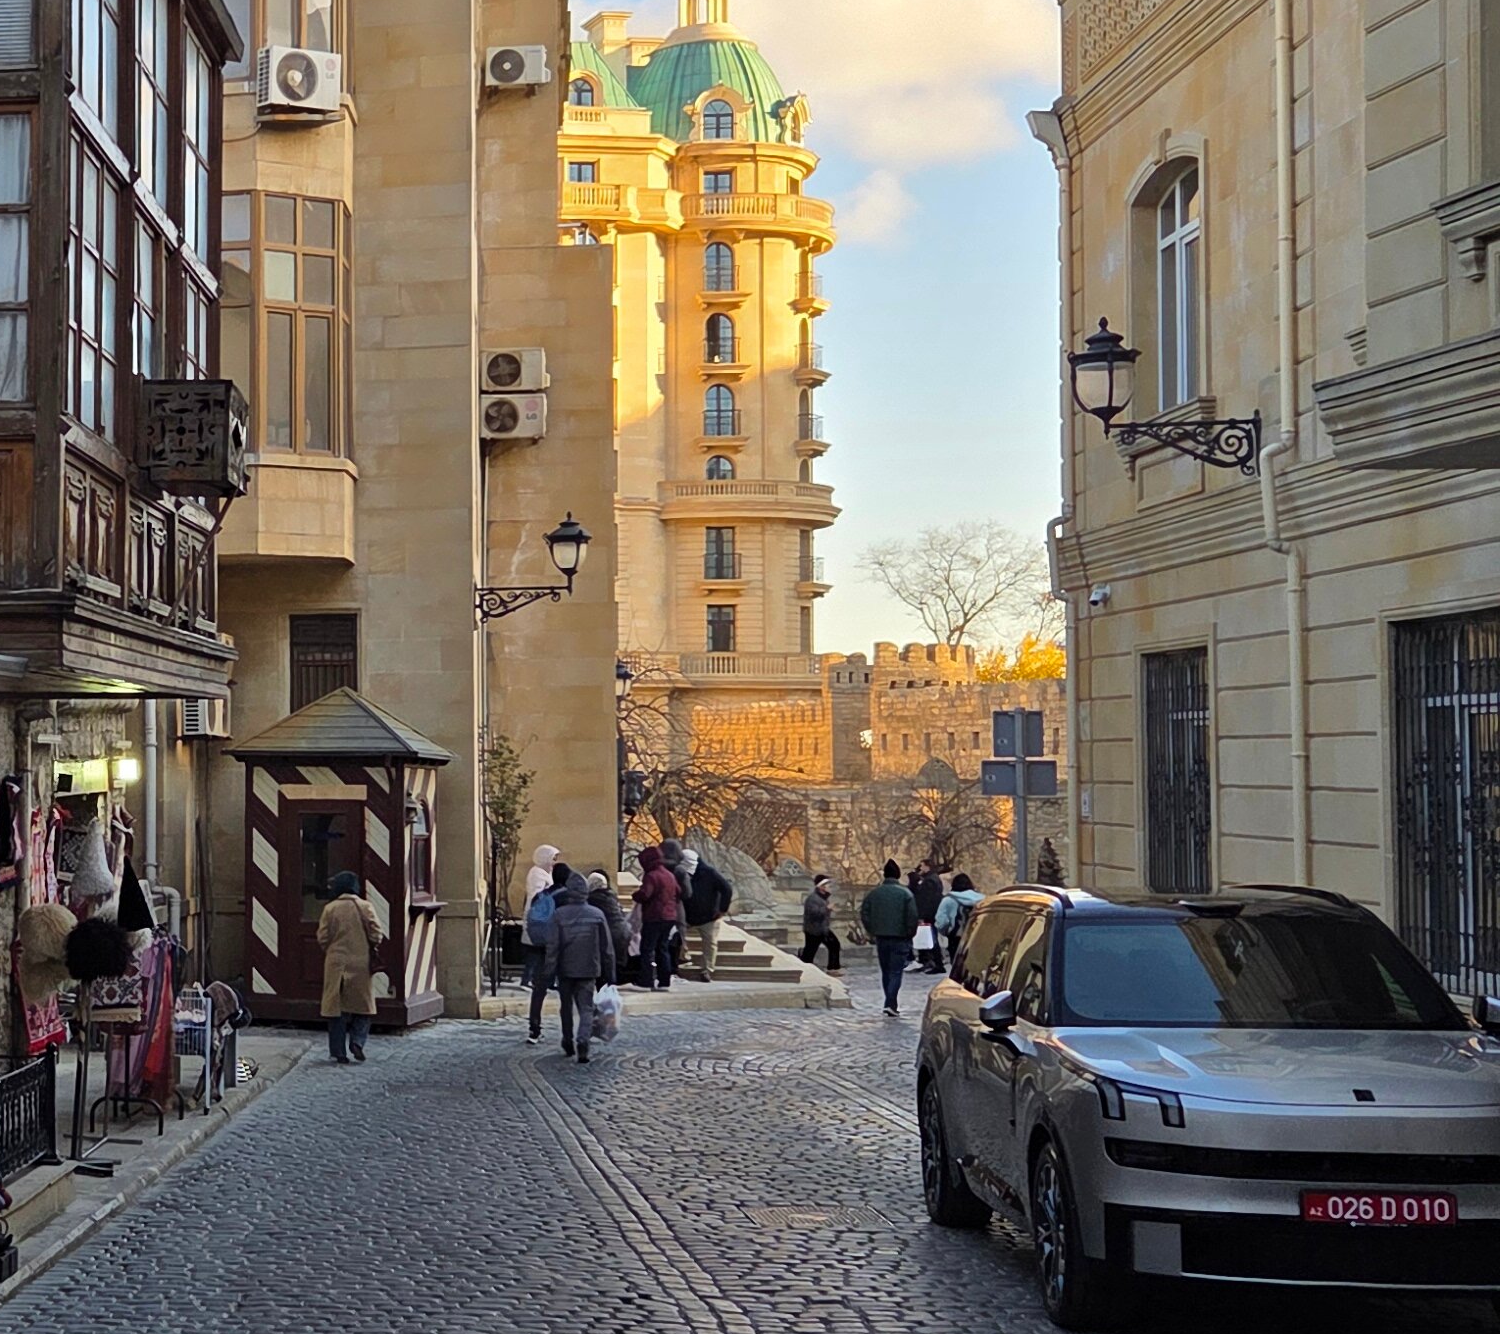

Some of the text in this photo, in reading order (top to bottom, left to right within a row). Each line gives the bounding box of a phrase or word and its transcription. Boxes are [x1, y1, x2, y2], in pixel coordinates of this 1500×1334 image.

[1309, 1196, 1450, 1222] AZ 026 D 010
